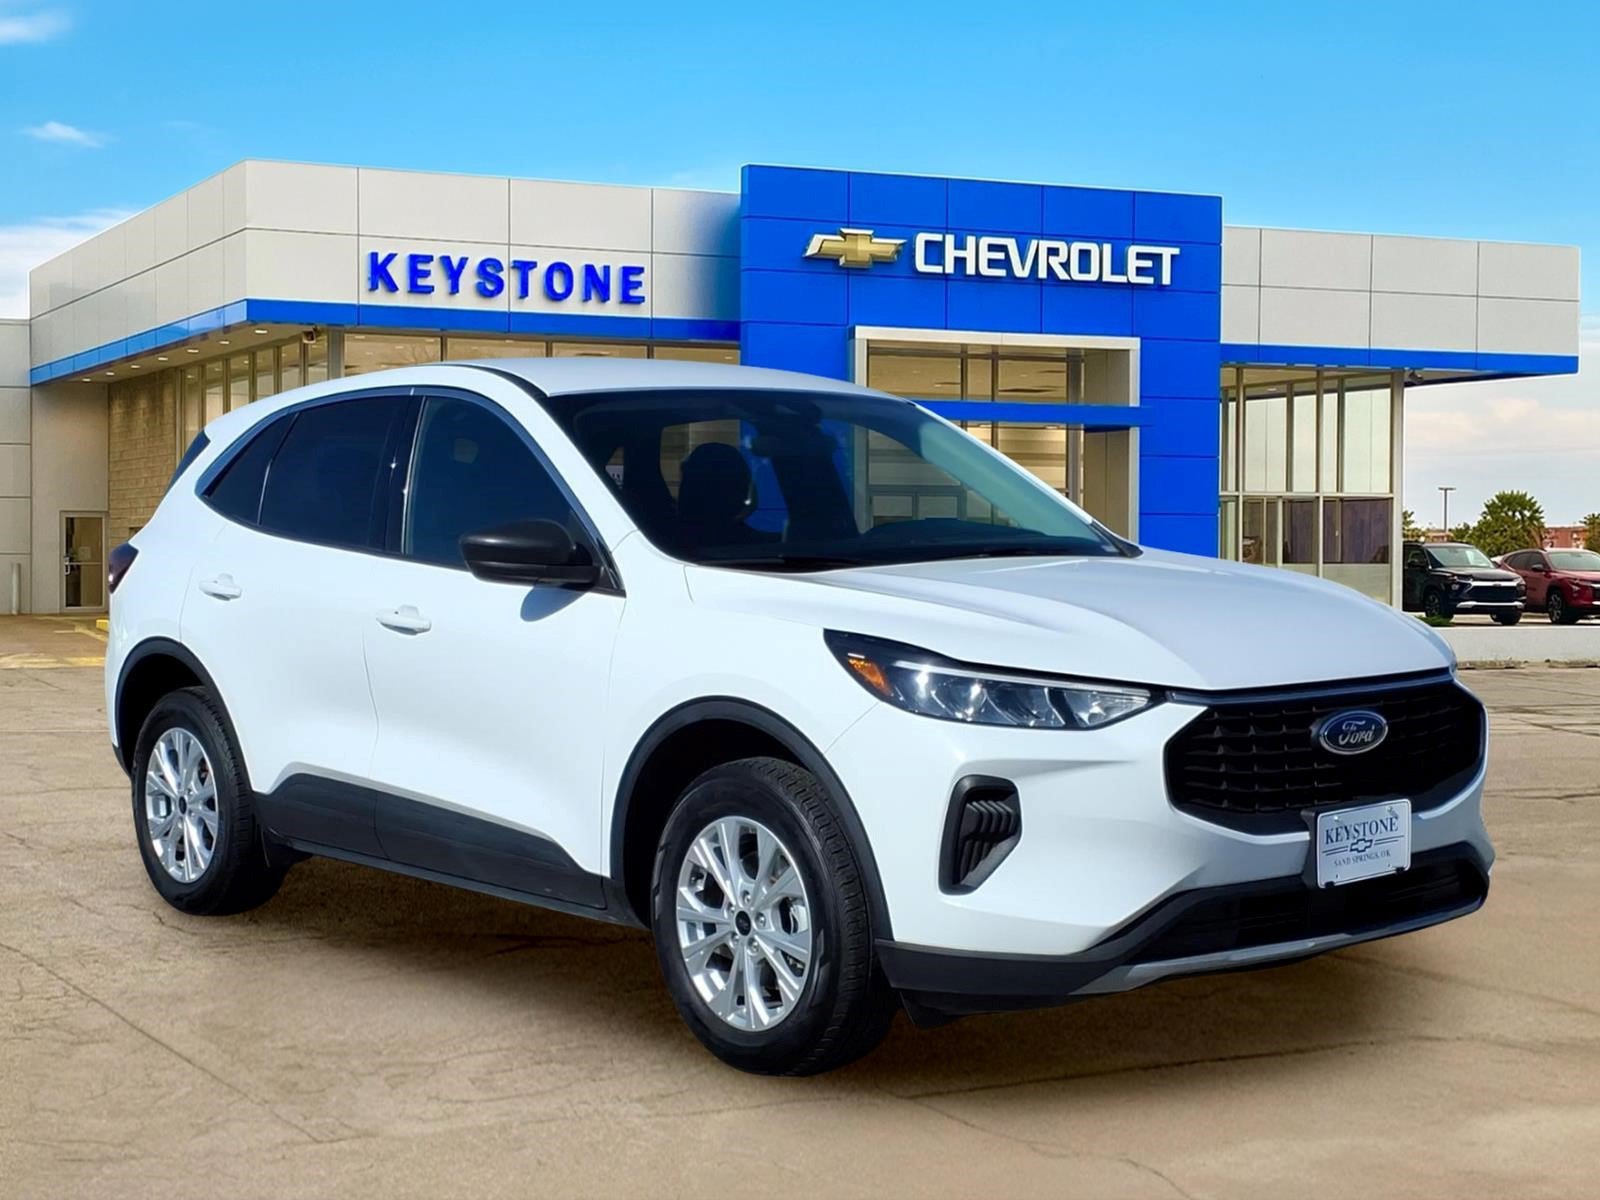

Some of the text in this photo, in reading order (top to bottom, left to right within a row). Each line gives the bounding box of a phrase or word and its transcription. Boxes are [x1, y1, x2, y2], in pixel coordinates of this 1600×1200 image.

[368, 251, 646, 304] KEYSTONE
[914, 232, 1181, 286] CHEVROLET
[1338, 720, 1376, 745] Ford
[1325, 816, 1399, 845] KEYSTONE
